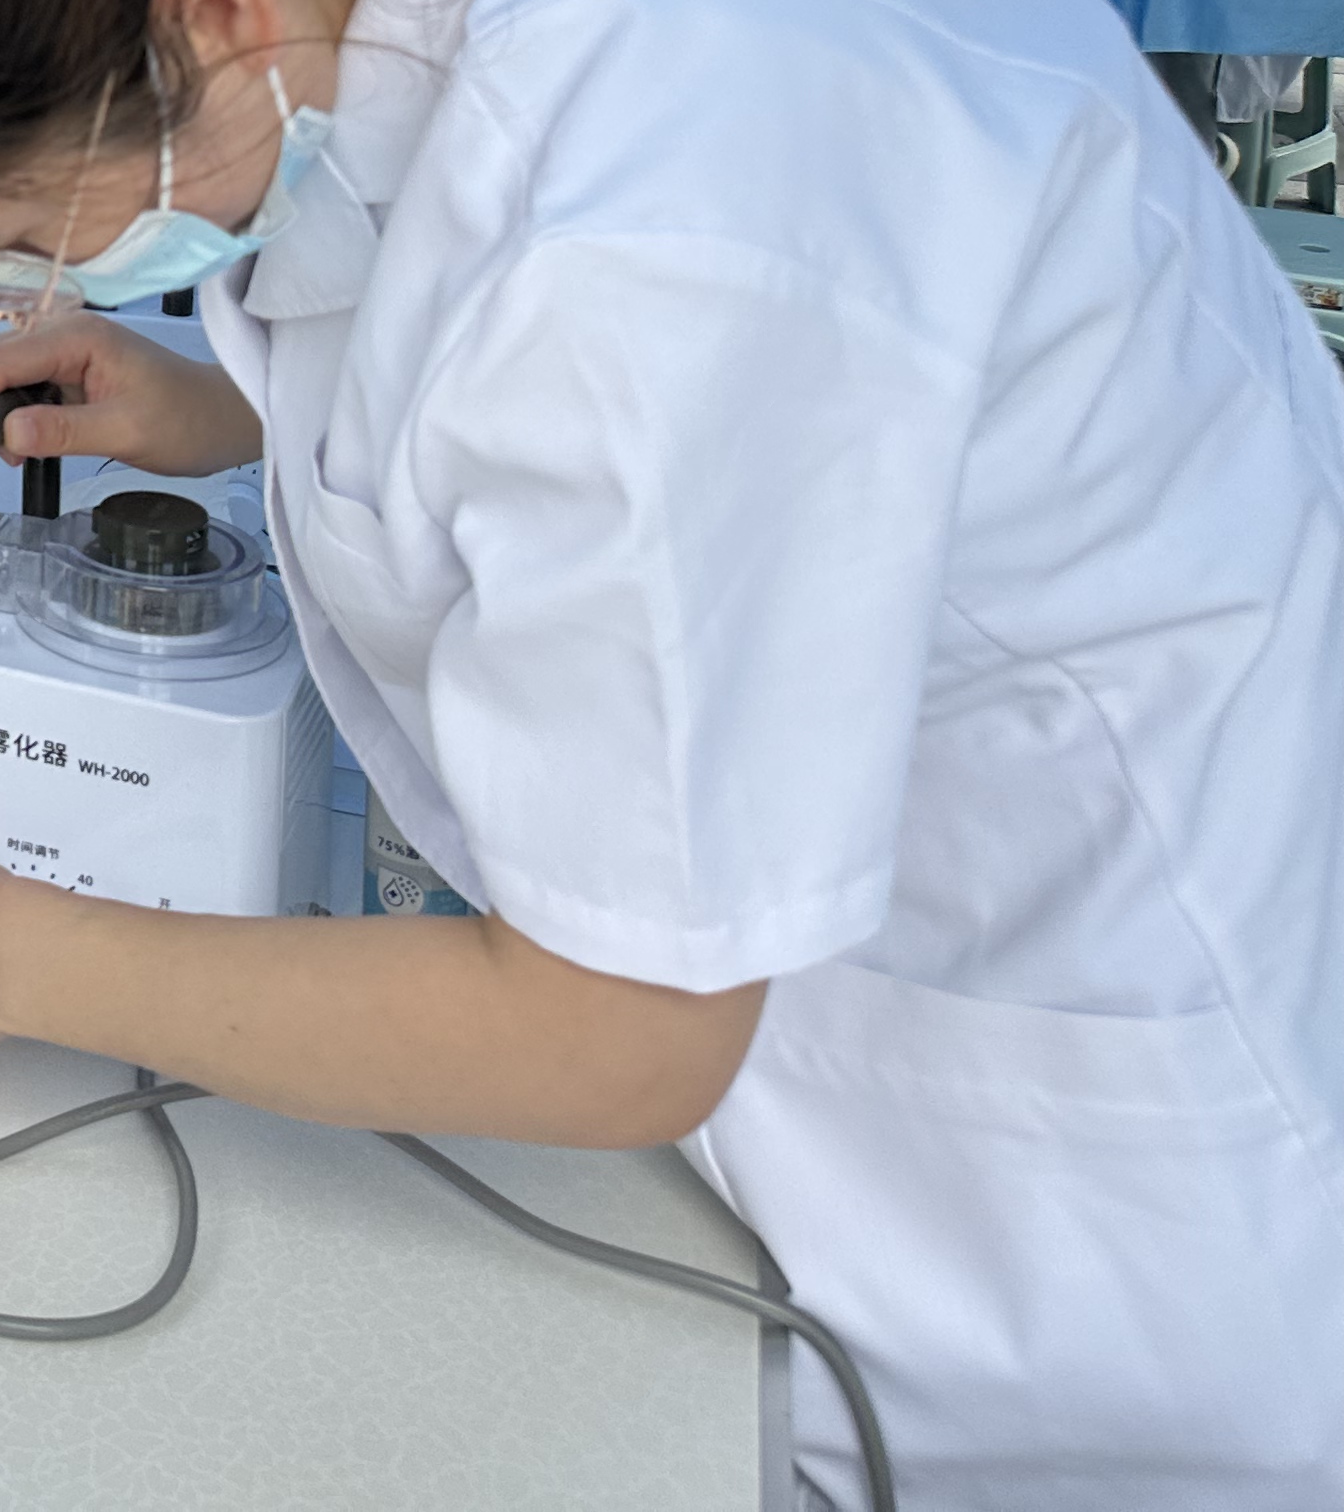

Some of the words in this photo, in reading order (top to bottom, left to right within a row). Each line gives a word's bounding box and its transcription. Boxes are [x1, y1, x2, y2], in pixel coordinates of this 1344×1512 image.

[77, 758, 150, 787] WH-2000
[7, 836, 60, 860] 时间调节
[77, 873, 94, 887] 40
